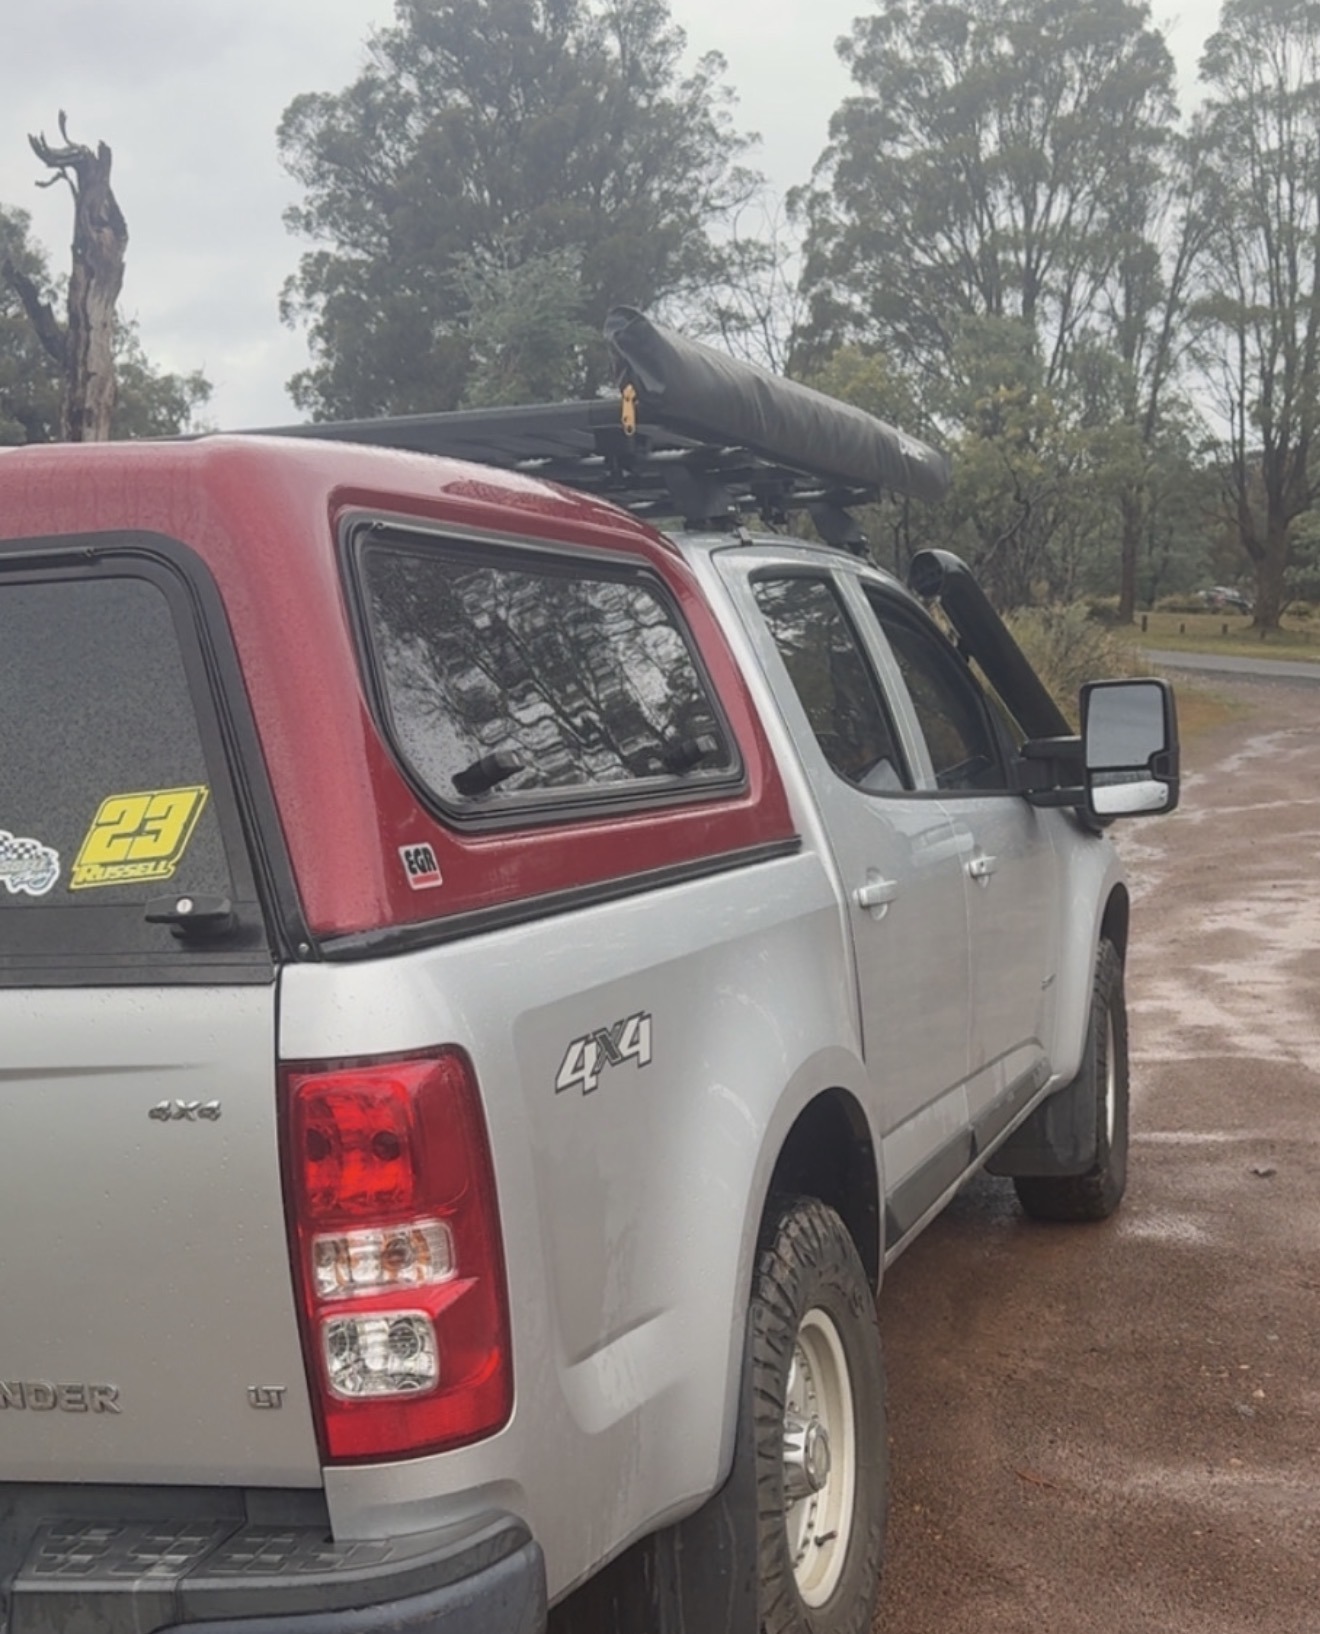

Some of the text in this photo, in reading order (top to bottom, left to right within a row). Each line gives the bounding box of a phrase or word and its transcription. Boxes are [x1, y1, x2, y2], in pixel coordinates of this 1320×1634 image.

[80, 789, 200, 864] 23
[404, 847, 437, 875] EGR
[247, 1385, 286, 1409] LT
